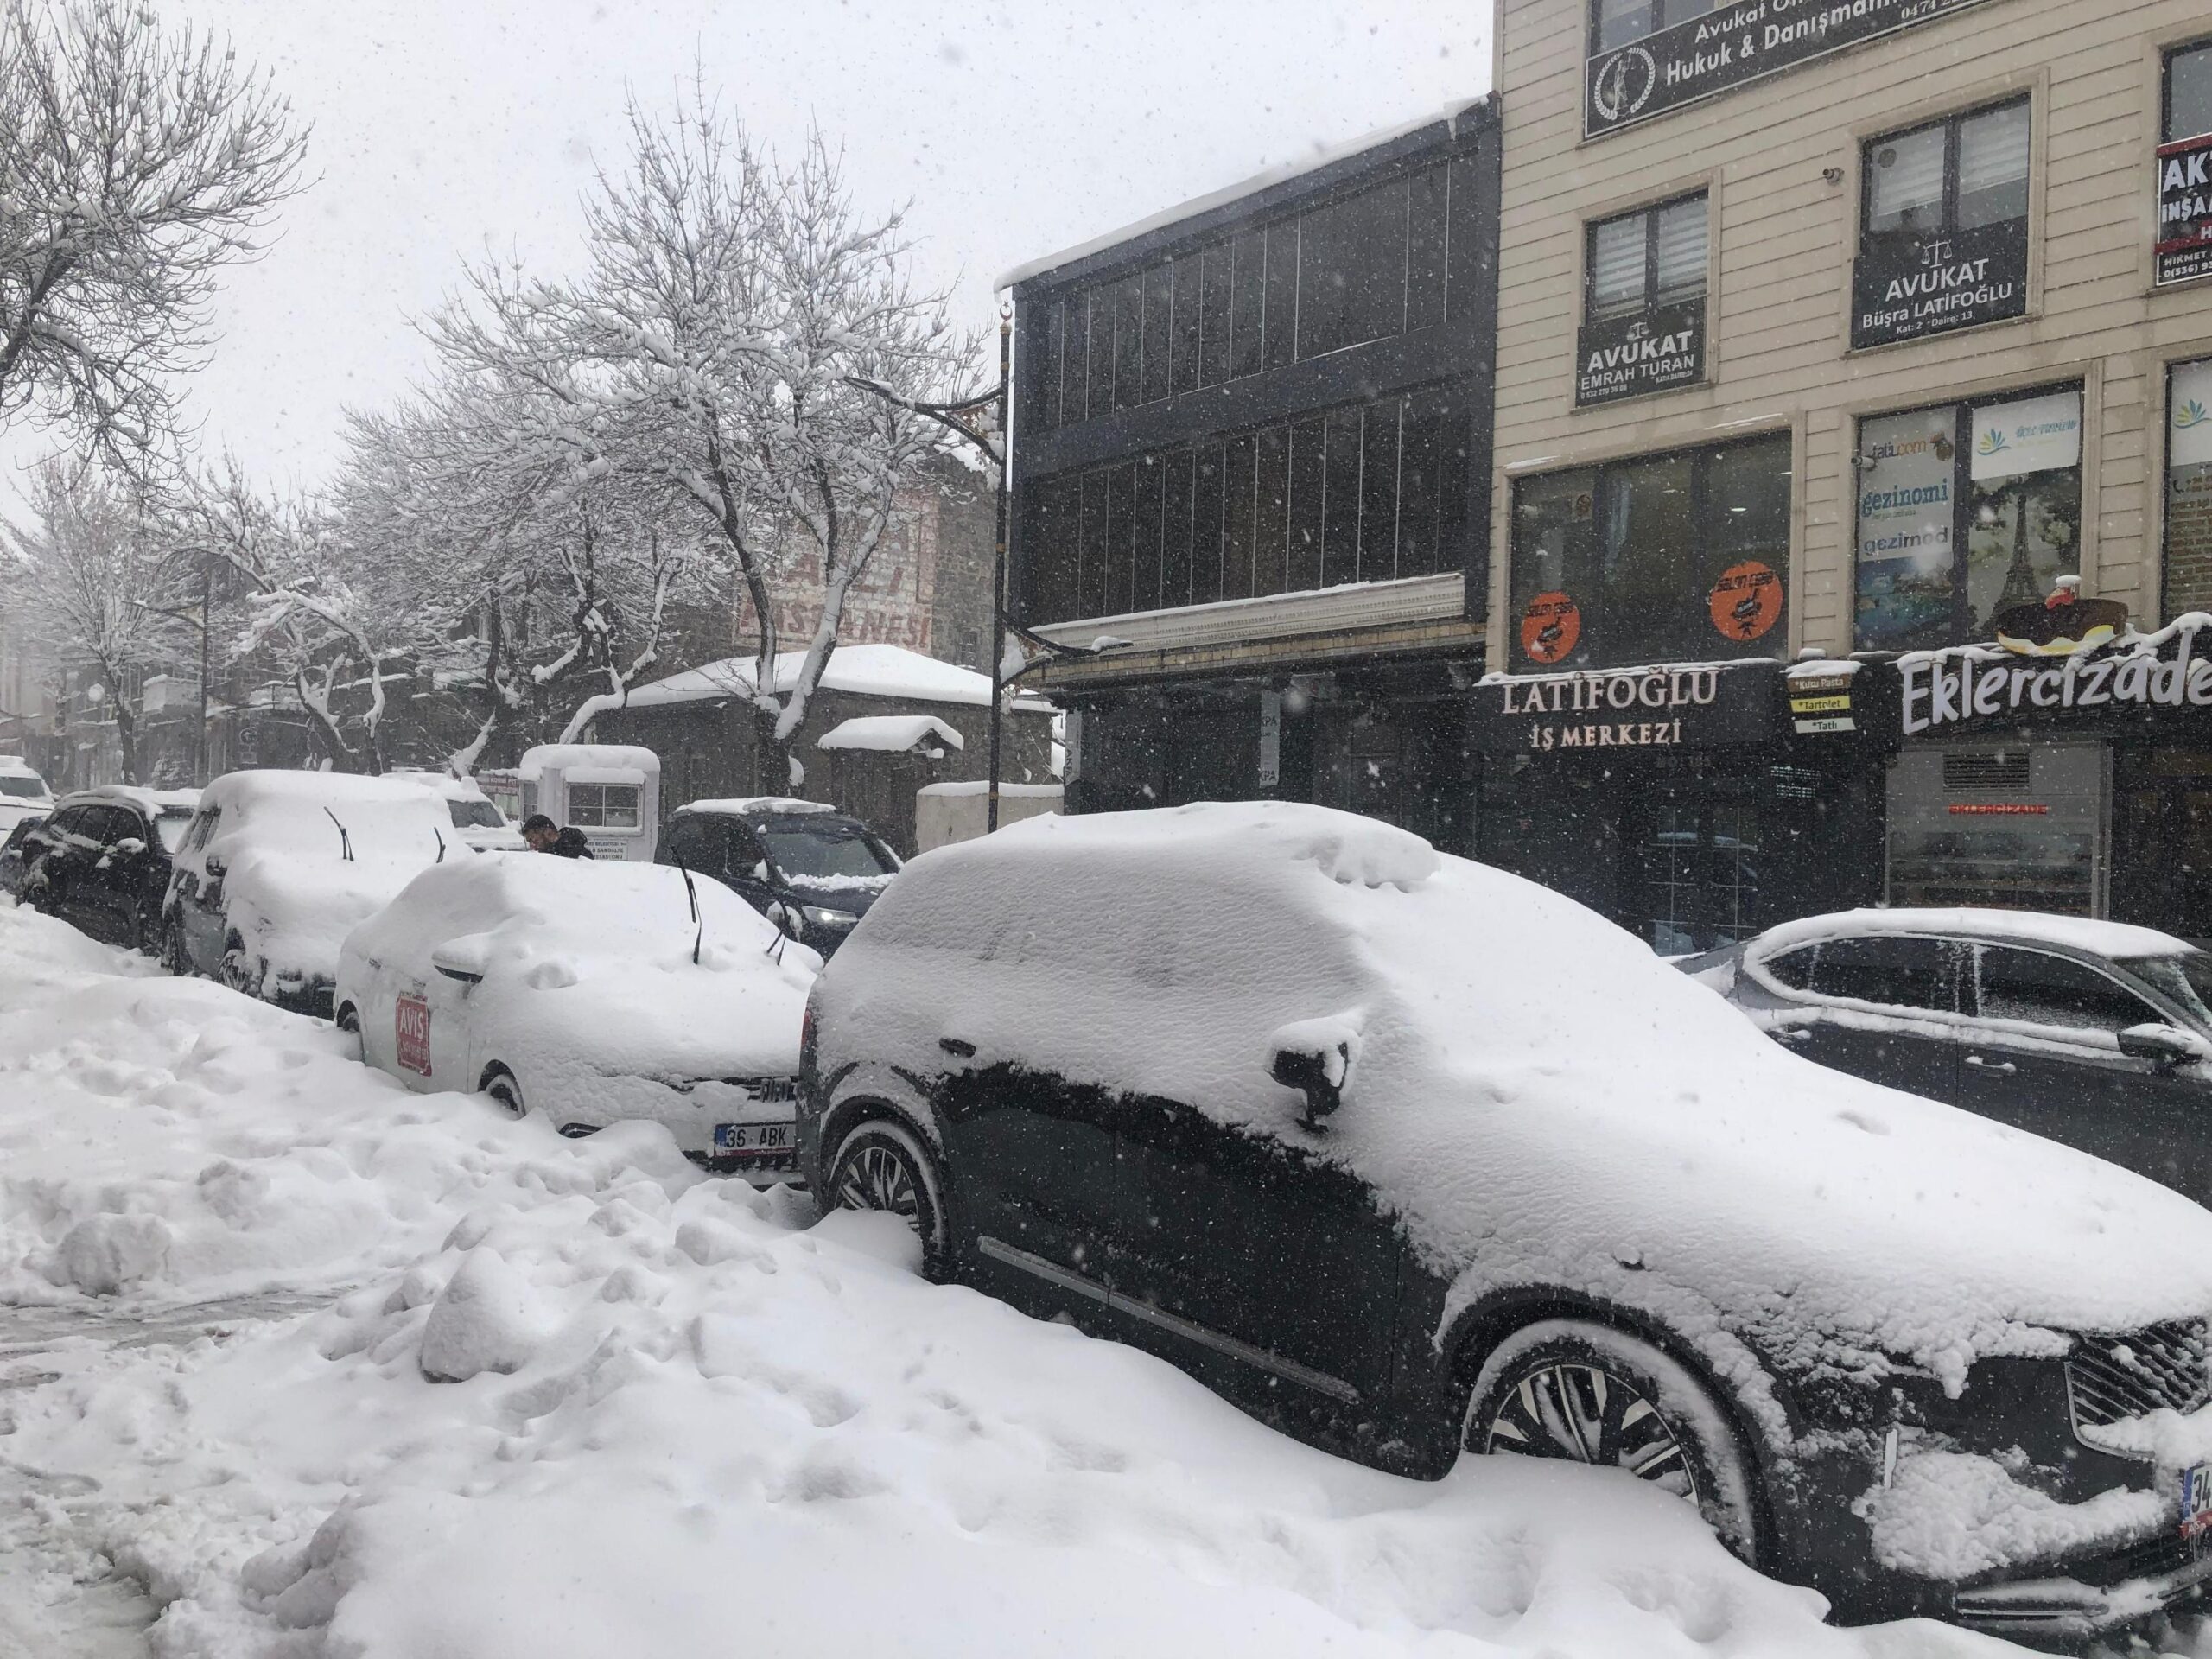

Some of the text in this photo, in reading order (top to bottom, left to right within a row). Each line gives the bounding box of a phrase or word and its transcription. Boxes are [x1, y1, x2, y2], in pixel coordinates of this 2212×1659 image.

[1666, 0, 1898, 86] Hukuk & Danışman
[1694, 3, 1766, 43] Avukat
[2163, 150, 2212, 193] AK
[2162, 195, 2212, 224] İNŞA
[1885, 258, 1990, 302] AVUKAT
[1862, 282, 2012, 329] Büşra LATİFOĞLU
[1896, 323, 1914, 334] Kat:
[1586, 329, 1694, 373] AVUKAT
[1580, 353, 1694, 391] EMRAH TURAN
[1861, 478, 1948, 518] gezinomi
[1864, 526, 1948, 556] gezimod
[1502, 666, 1719, 715] LATİFOĞLU
[1901, 628, 2212, 734] Eklercizade
[1530, 718, 1681, 751] İŞ MERKEZİ
[399, 1007, 424, 1041] AVIS
[727, 1127, 788, 1148] 36 ABK
[2191, 1470, 2211, 1514] 34
